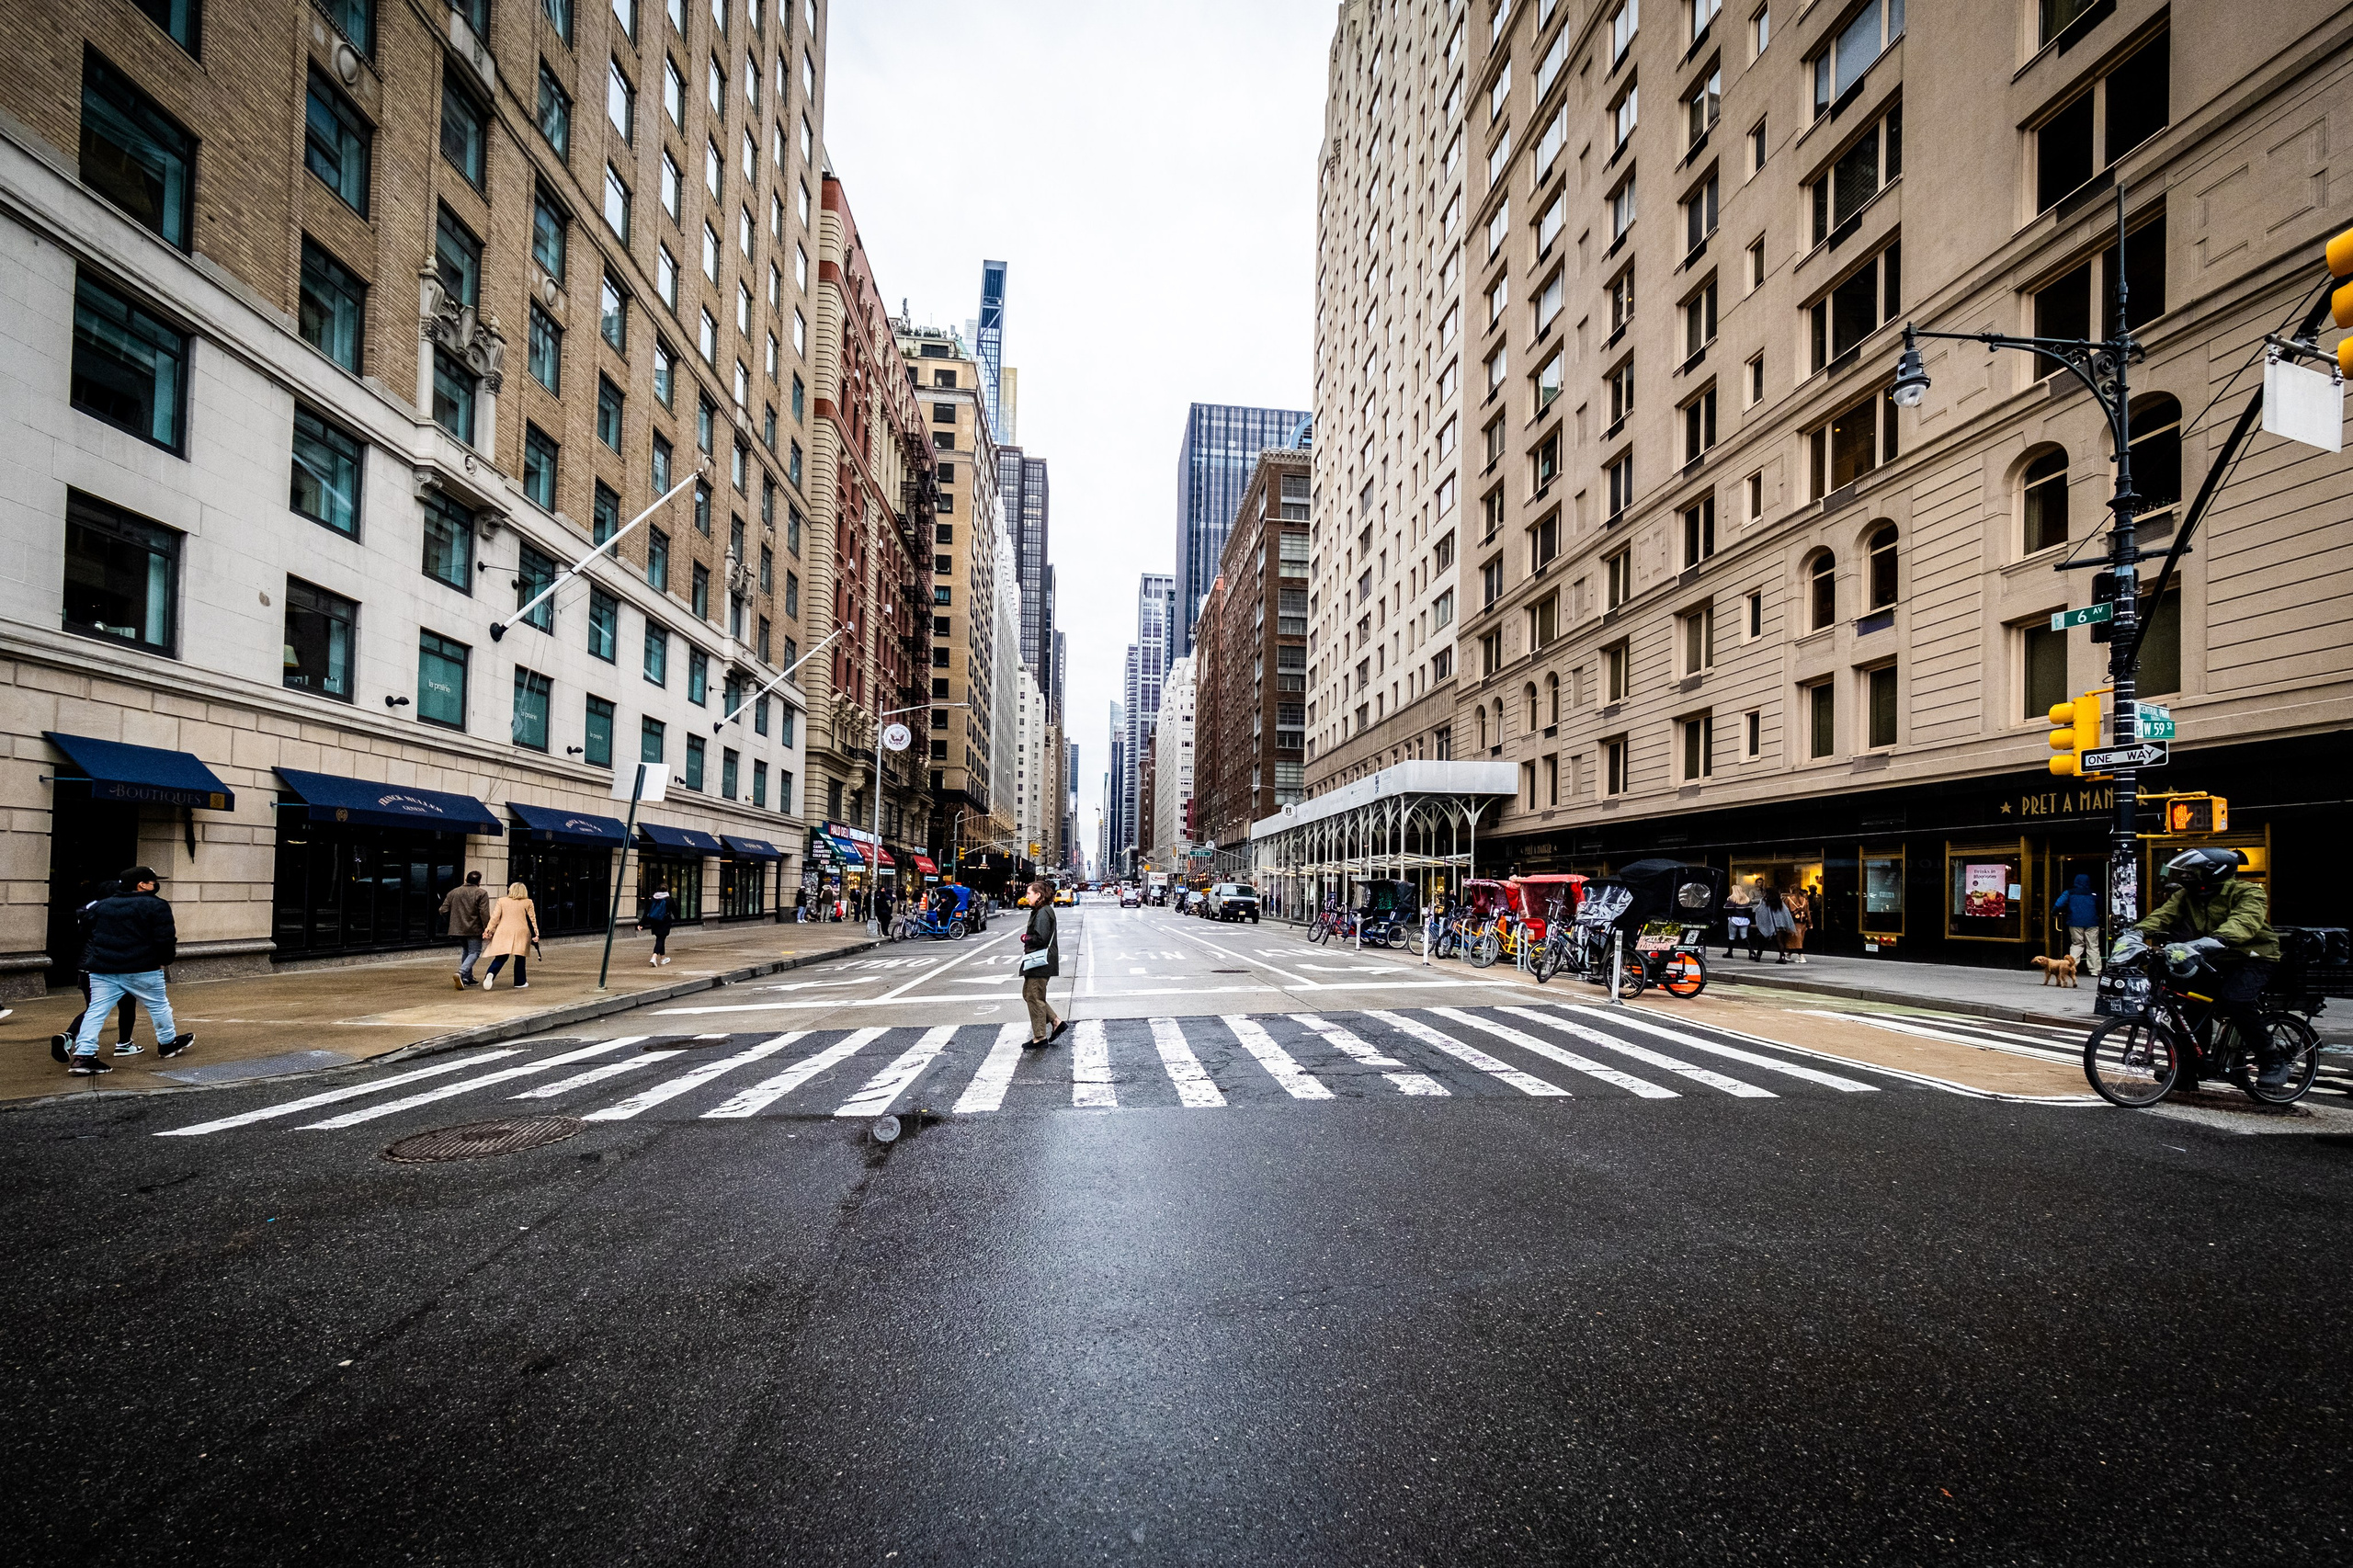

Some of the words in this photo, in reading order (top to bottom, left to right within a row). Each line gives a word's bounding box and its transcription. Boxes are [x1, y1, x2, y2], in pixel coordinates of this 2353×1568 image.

[2077, 610, 2087, 623] 6
[2093, 607, 2103, 615] AV
[434, 683, 450, 693] prairie
[2143, 722, 2151, 735] W
[2154, 722, 2165, 735] 59
[2088, 755, 2112, 765] ONE
[2127, 749, 2154, 761] WAY
[2022, 792, 2057, 815] PRET
[2063, 792, 2073, 812] A
[2080, 784, 2148, 811] MANR
[830, 824, 840, 836] HALO
[840, 826, 849, 838] DELI
